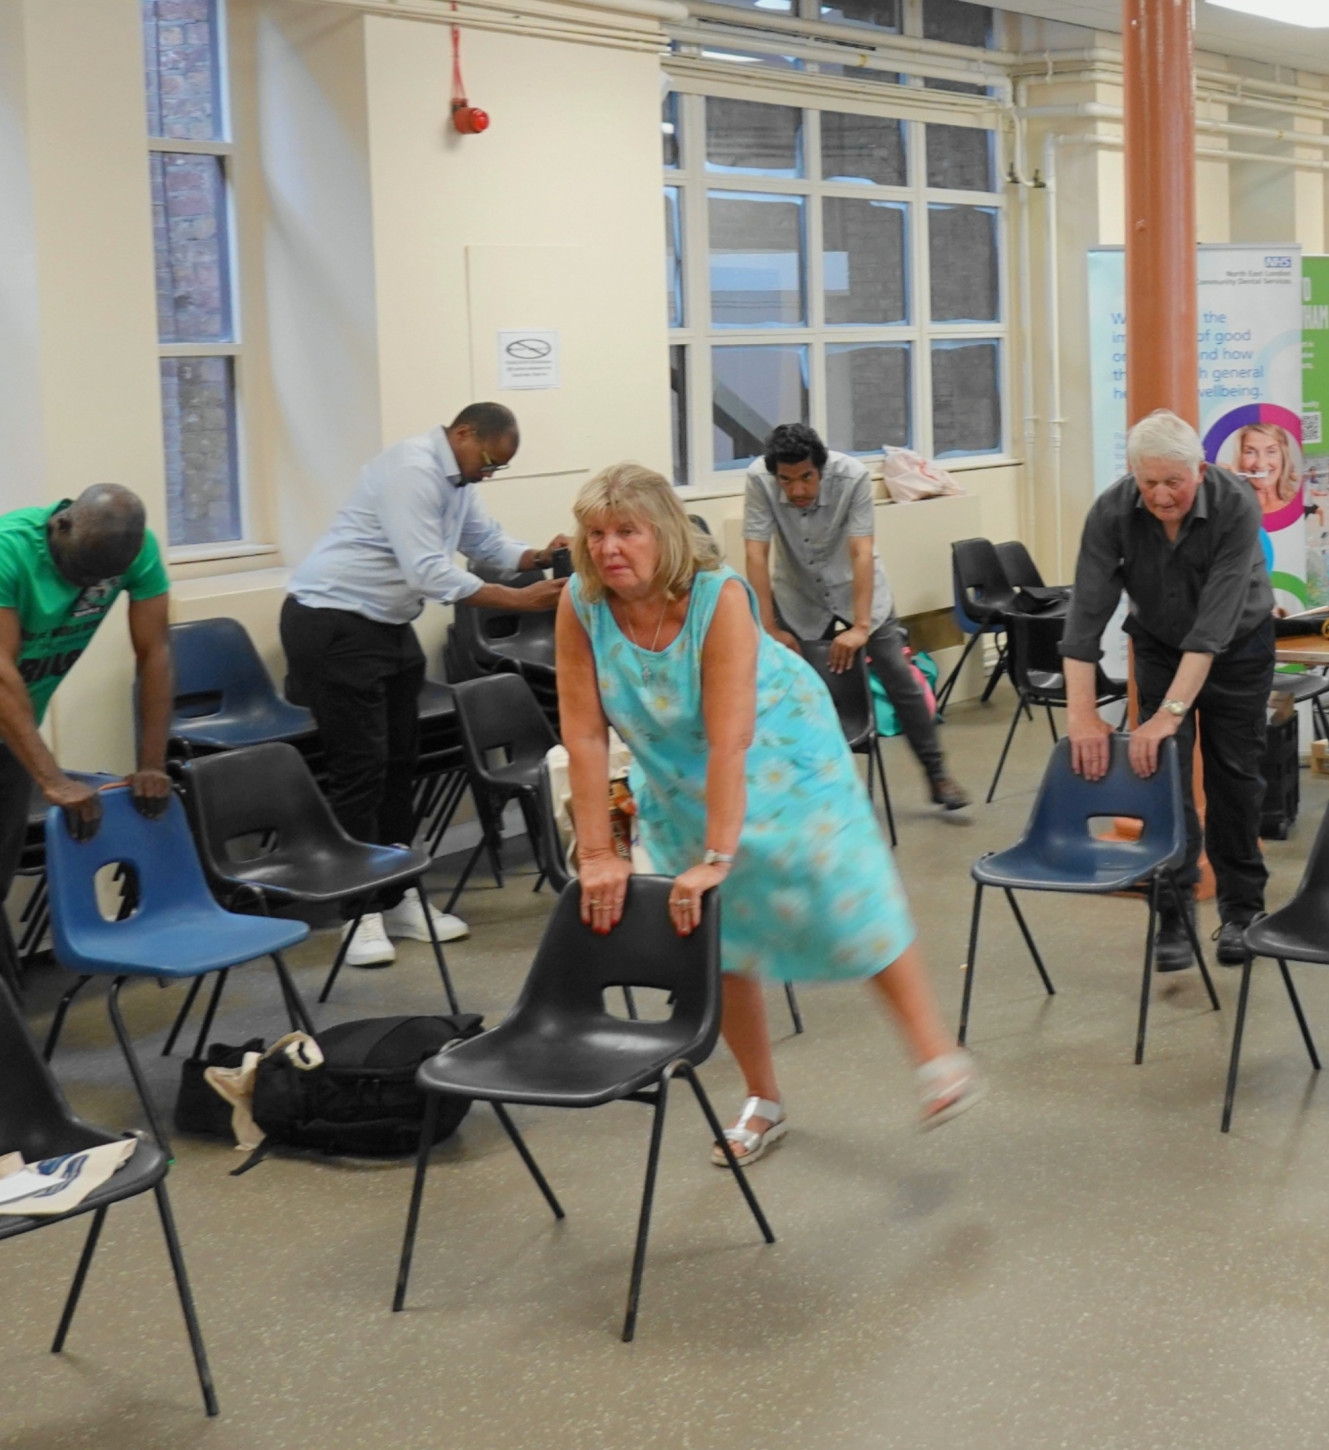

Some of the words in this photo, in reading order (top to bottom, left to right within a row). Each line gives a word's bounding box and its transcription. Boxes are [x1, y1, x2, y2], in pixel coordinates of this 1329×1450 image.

[1265, 256, 1292, 268] NHS
[1203, 310, 1227, 323] the
[1197, 328, 1211, 342] of
[1214, 327, 1251, 345] good
[1198, 347, 1218, 361] nd
[1222, 347, 1253, 360] how
[1211, 364, 1264, 382] general
